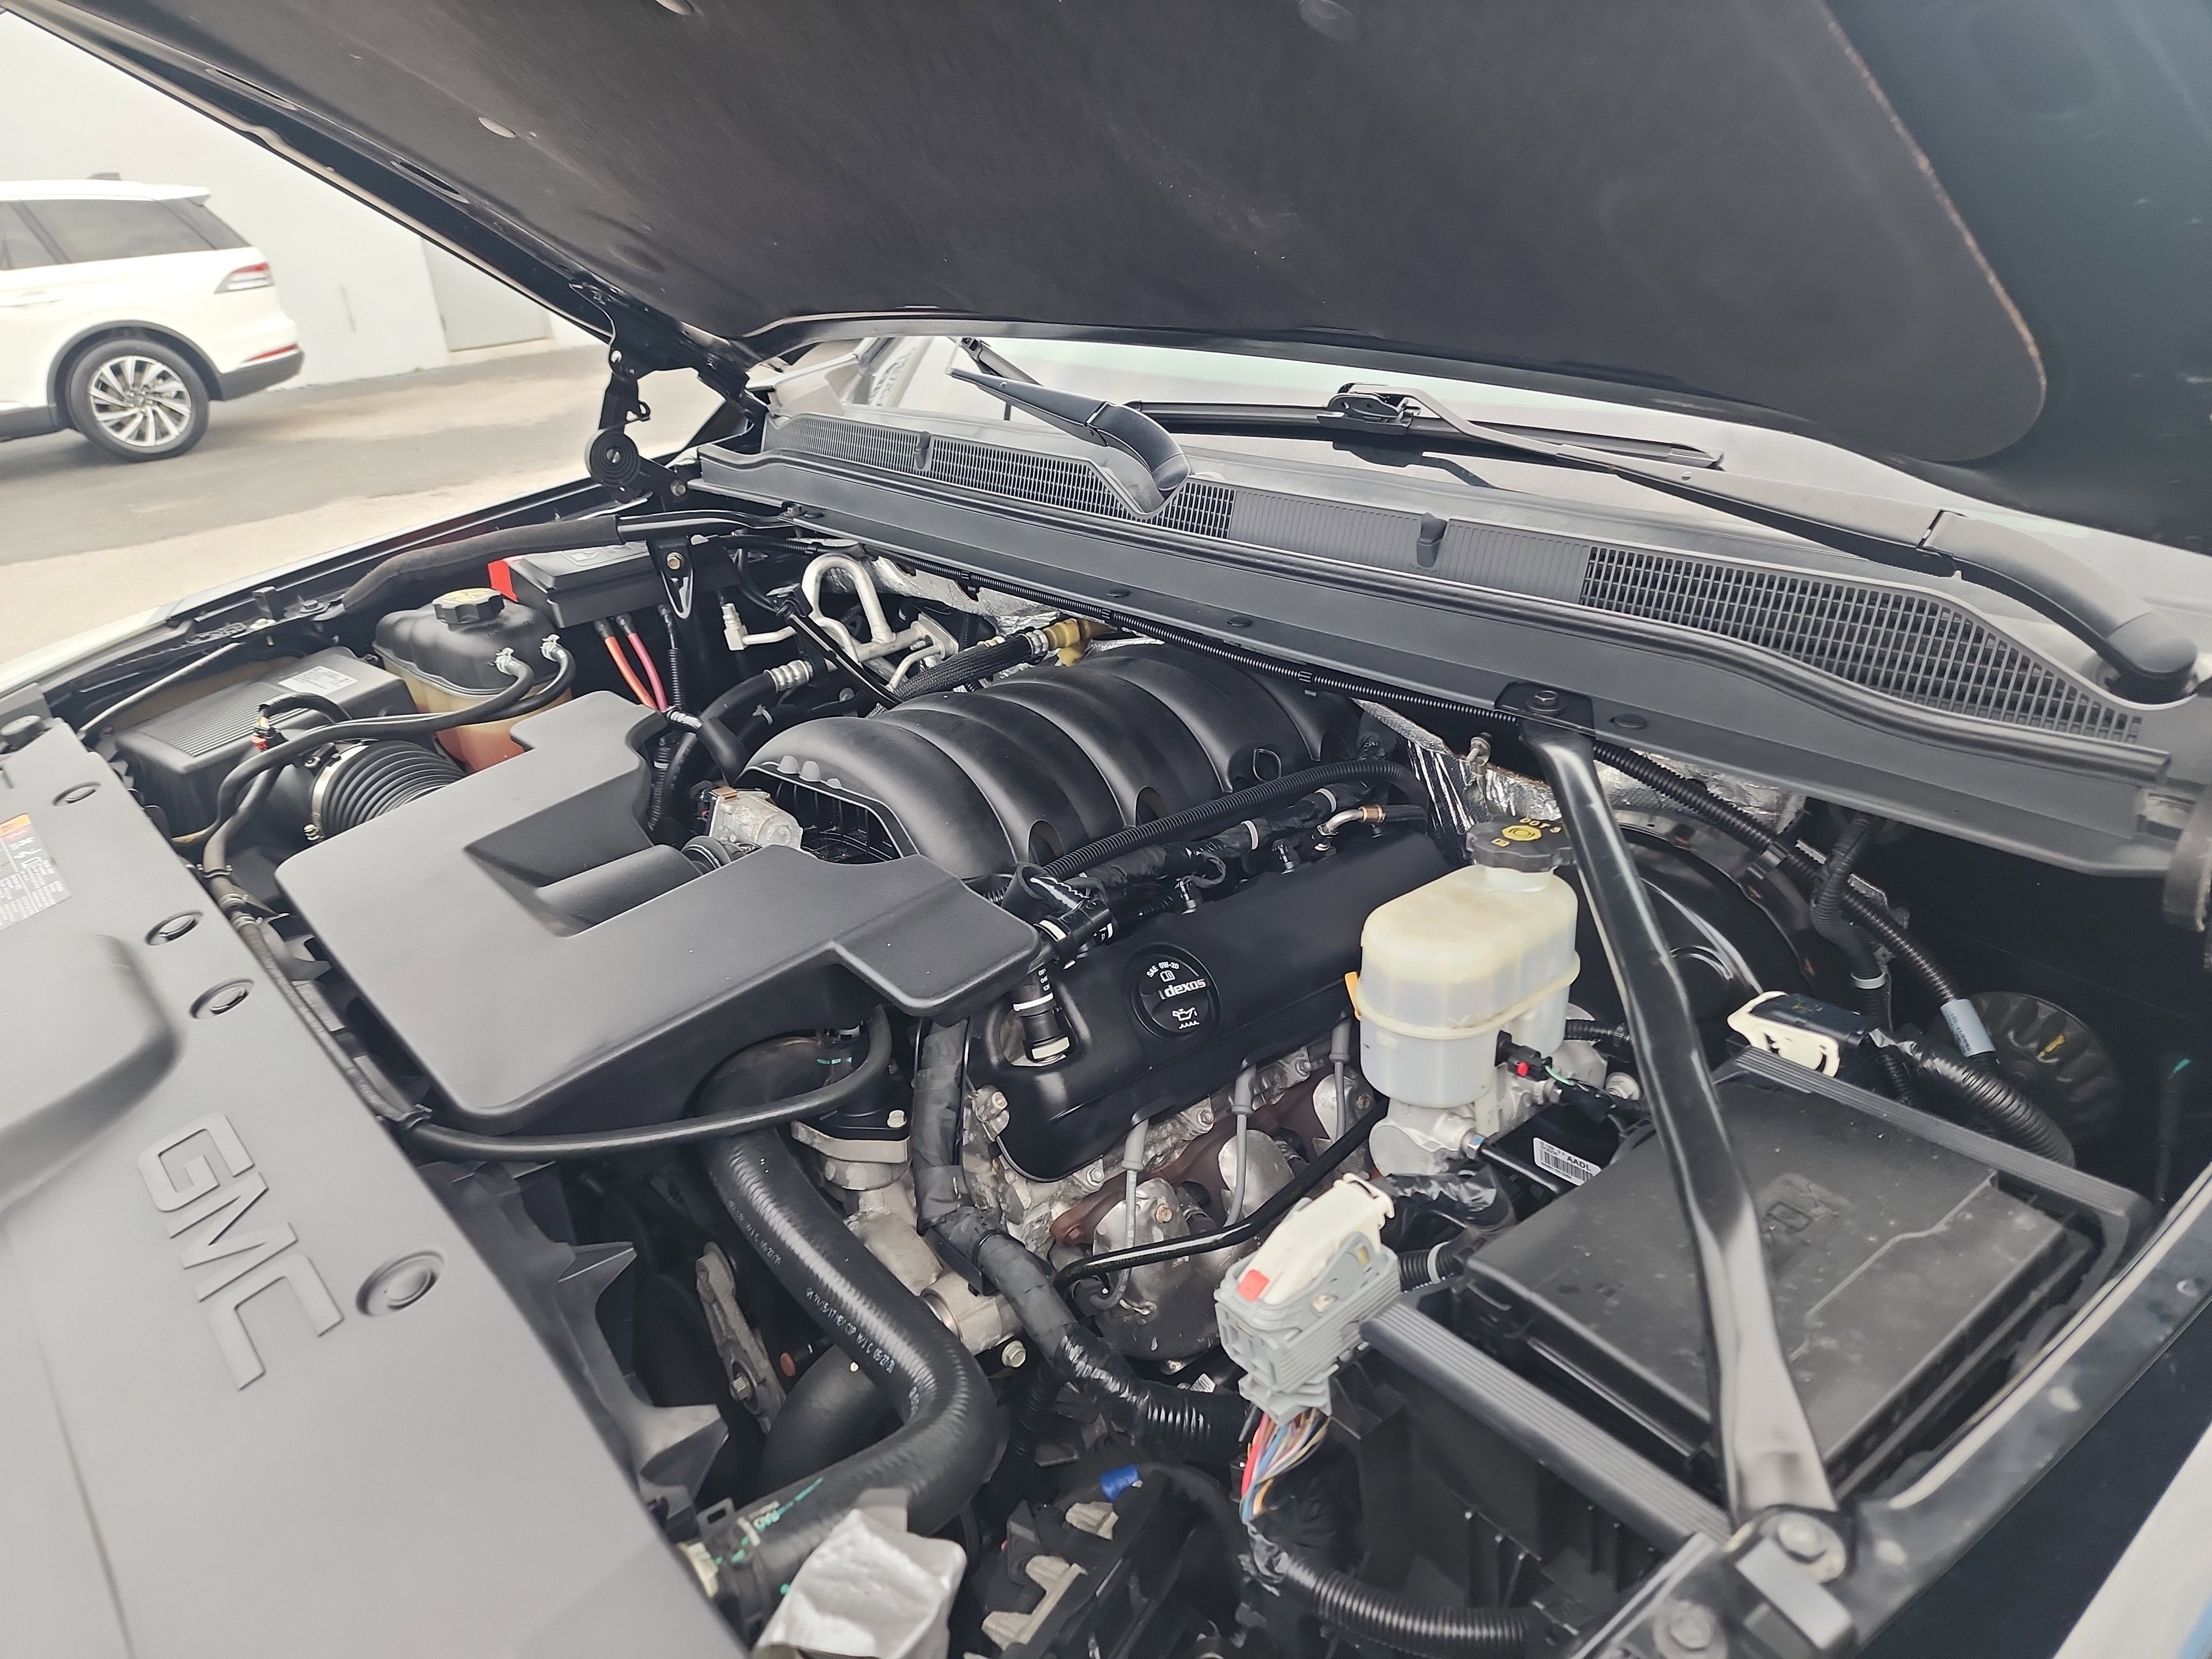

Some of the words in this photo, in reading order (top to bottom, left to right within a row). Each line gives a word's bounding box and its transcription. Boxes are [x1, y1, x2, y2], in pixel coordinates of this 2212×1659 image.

[1519, 818, 1551, 828] DOT
[1146, 965, 1159, 978] SAE
[1158, 961, 1180, 969] 0W-20
[1164, 978, 1206, 998] dexos
[1567, 1156, 1592, 1172] AADL
[137, 1112, 345, 1391] GMC
